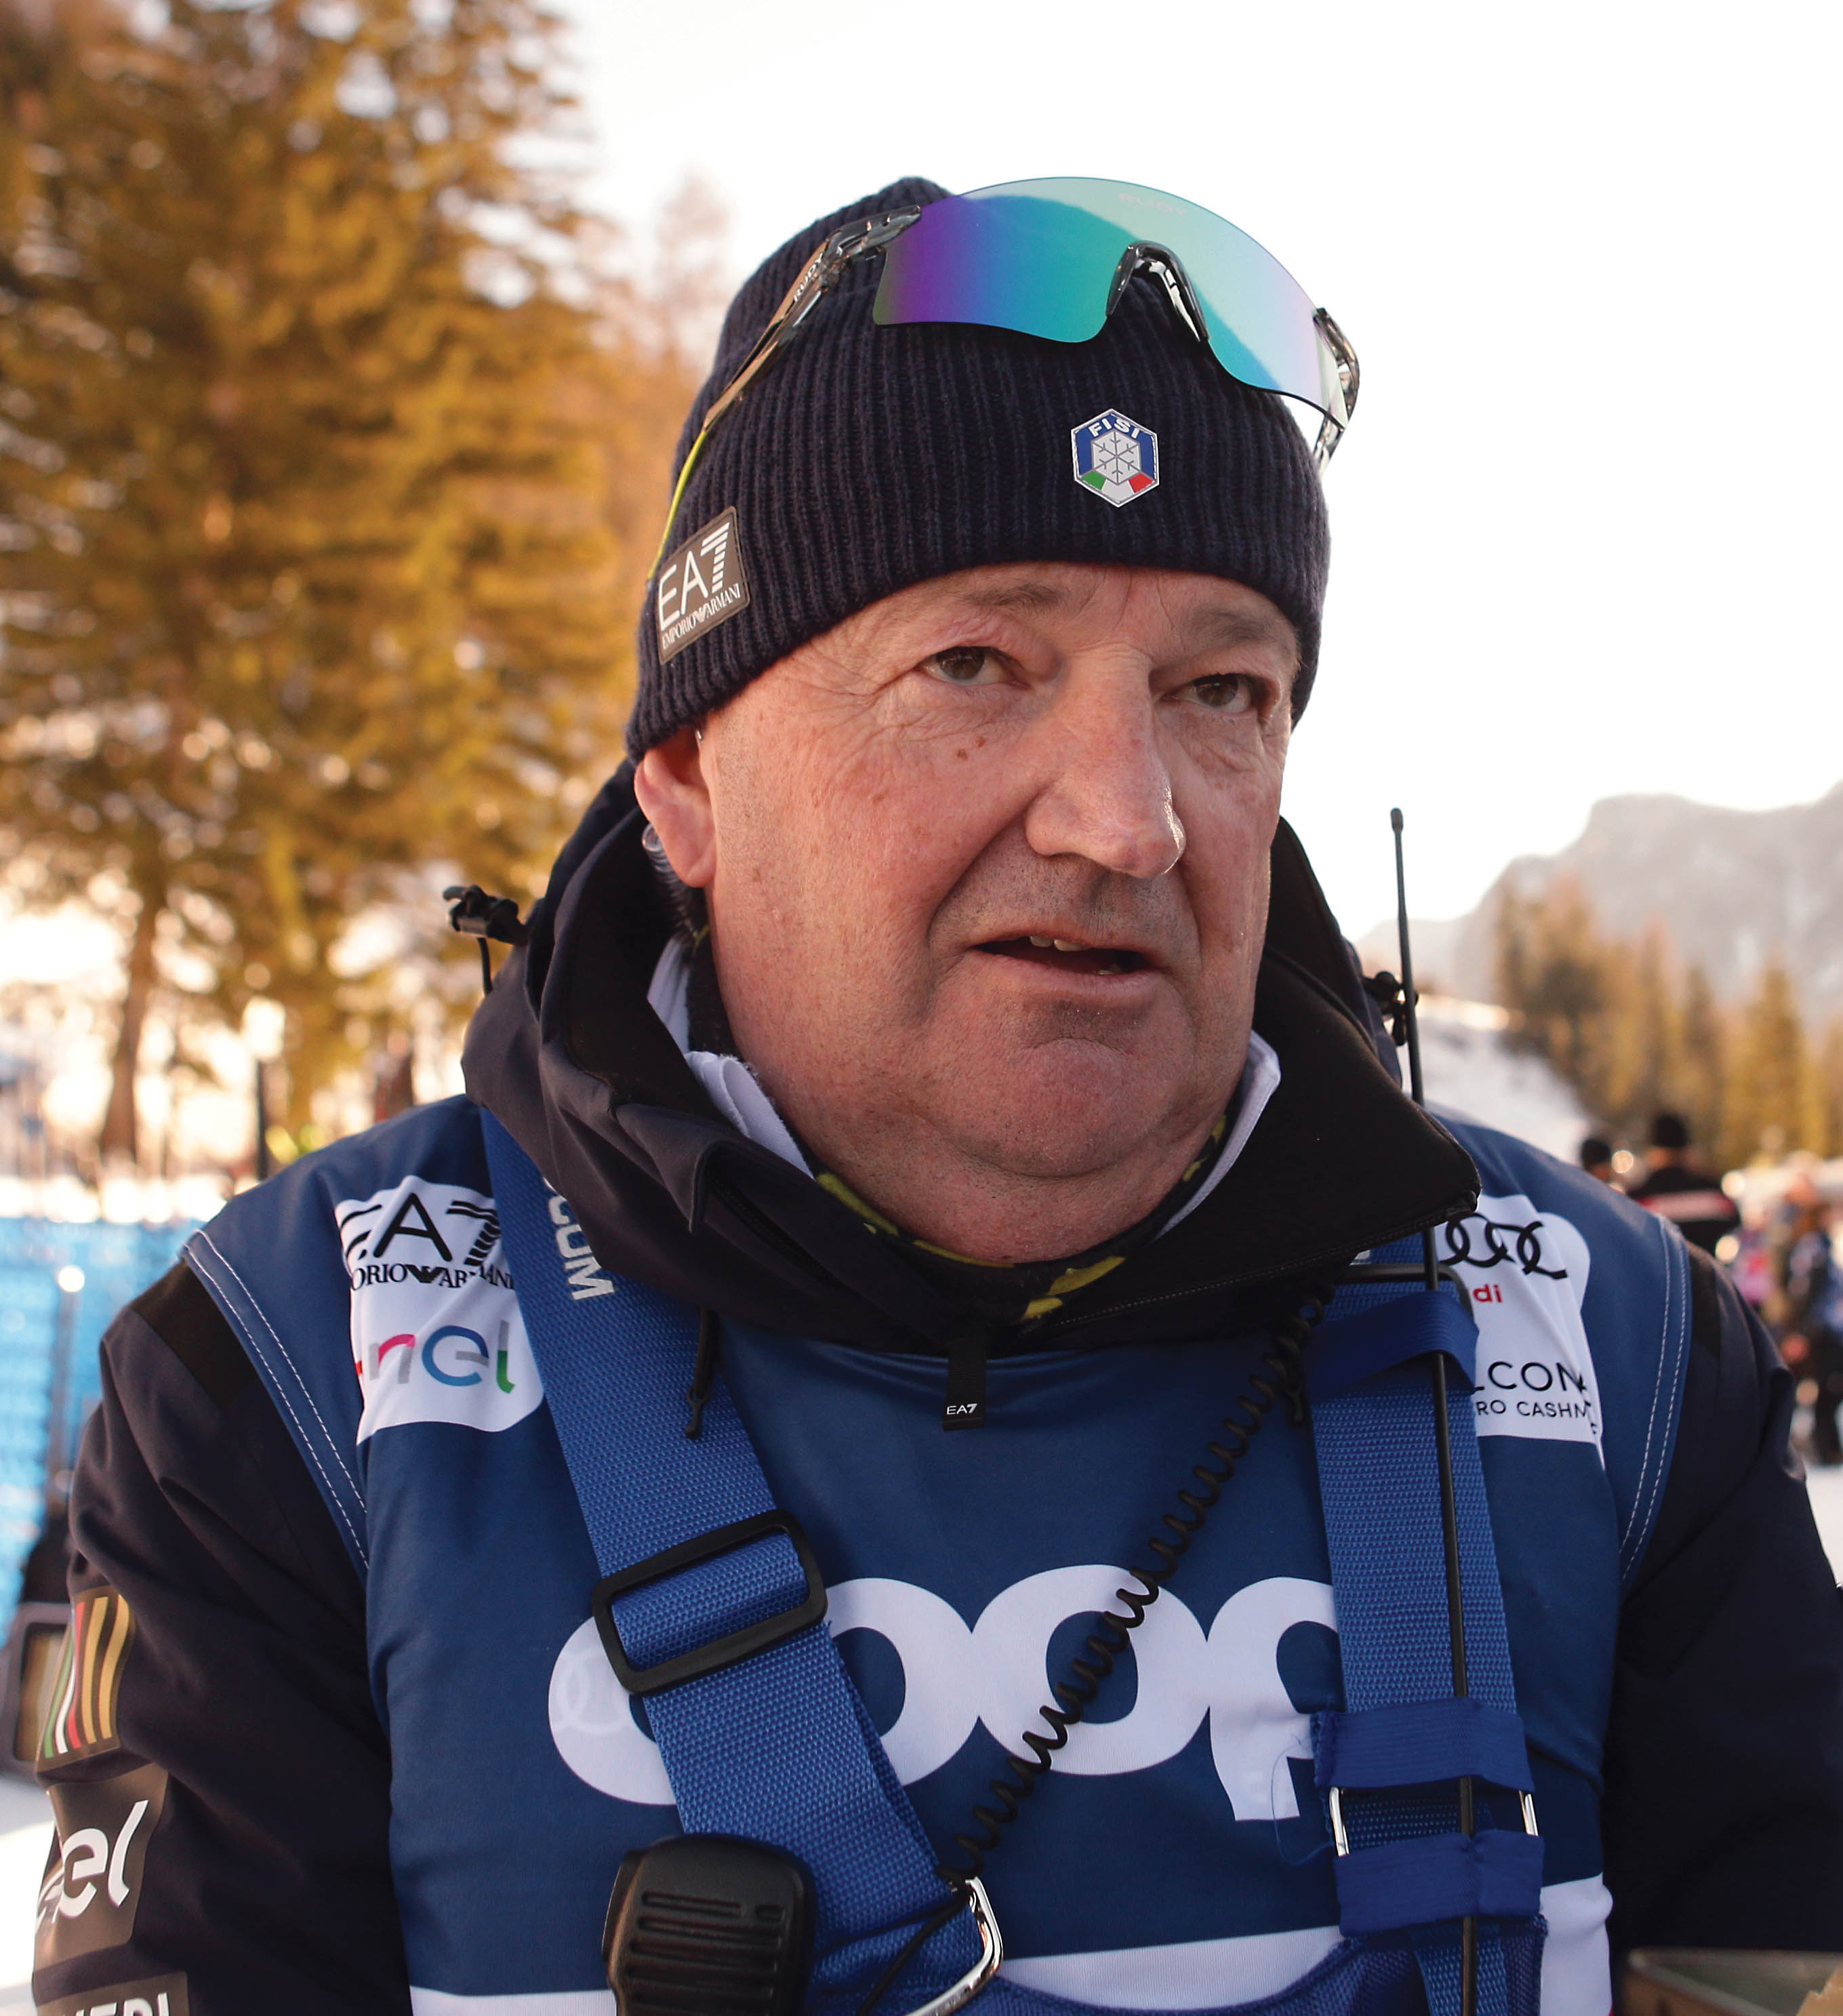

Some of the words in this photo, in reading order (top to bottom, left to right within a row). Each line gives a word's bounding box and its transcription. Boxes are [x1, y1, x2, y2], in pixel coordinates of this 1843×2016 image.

[1088, 418, 1140, 439] FISI
[659, 522, 730, 631] EA7
[543, 1176, 615, 1300] COM
[355, 1321, 515, 1394] nel
[1476, 1361, 1586, 1392] CON
[946, 1403, 977, 1415] EA7
